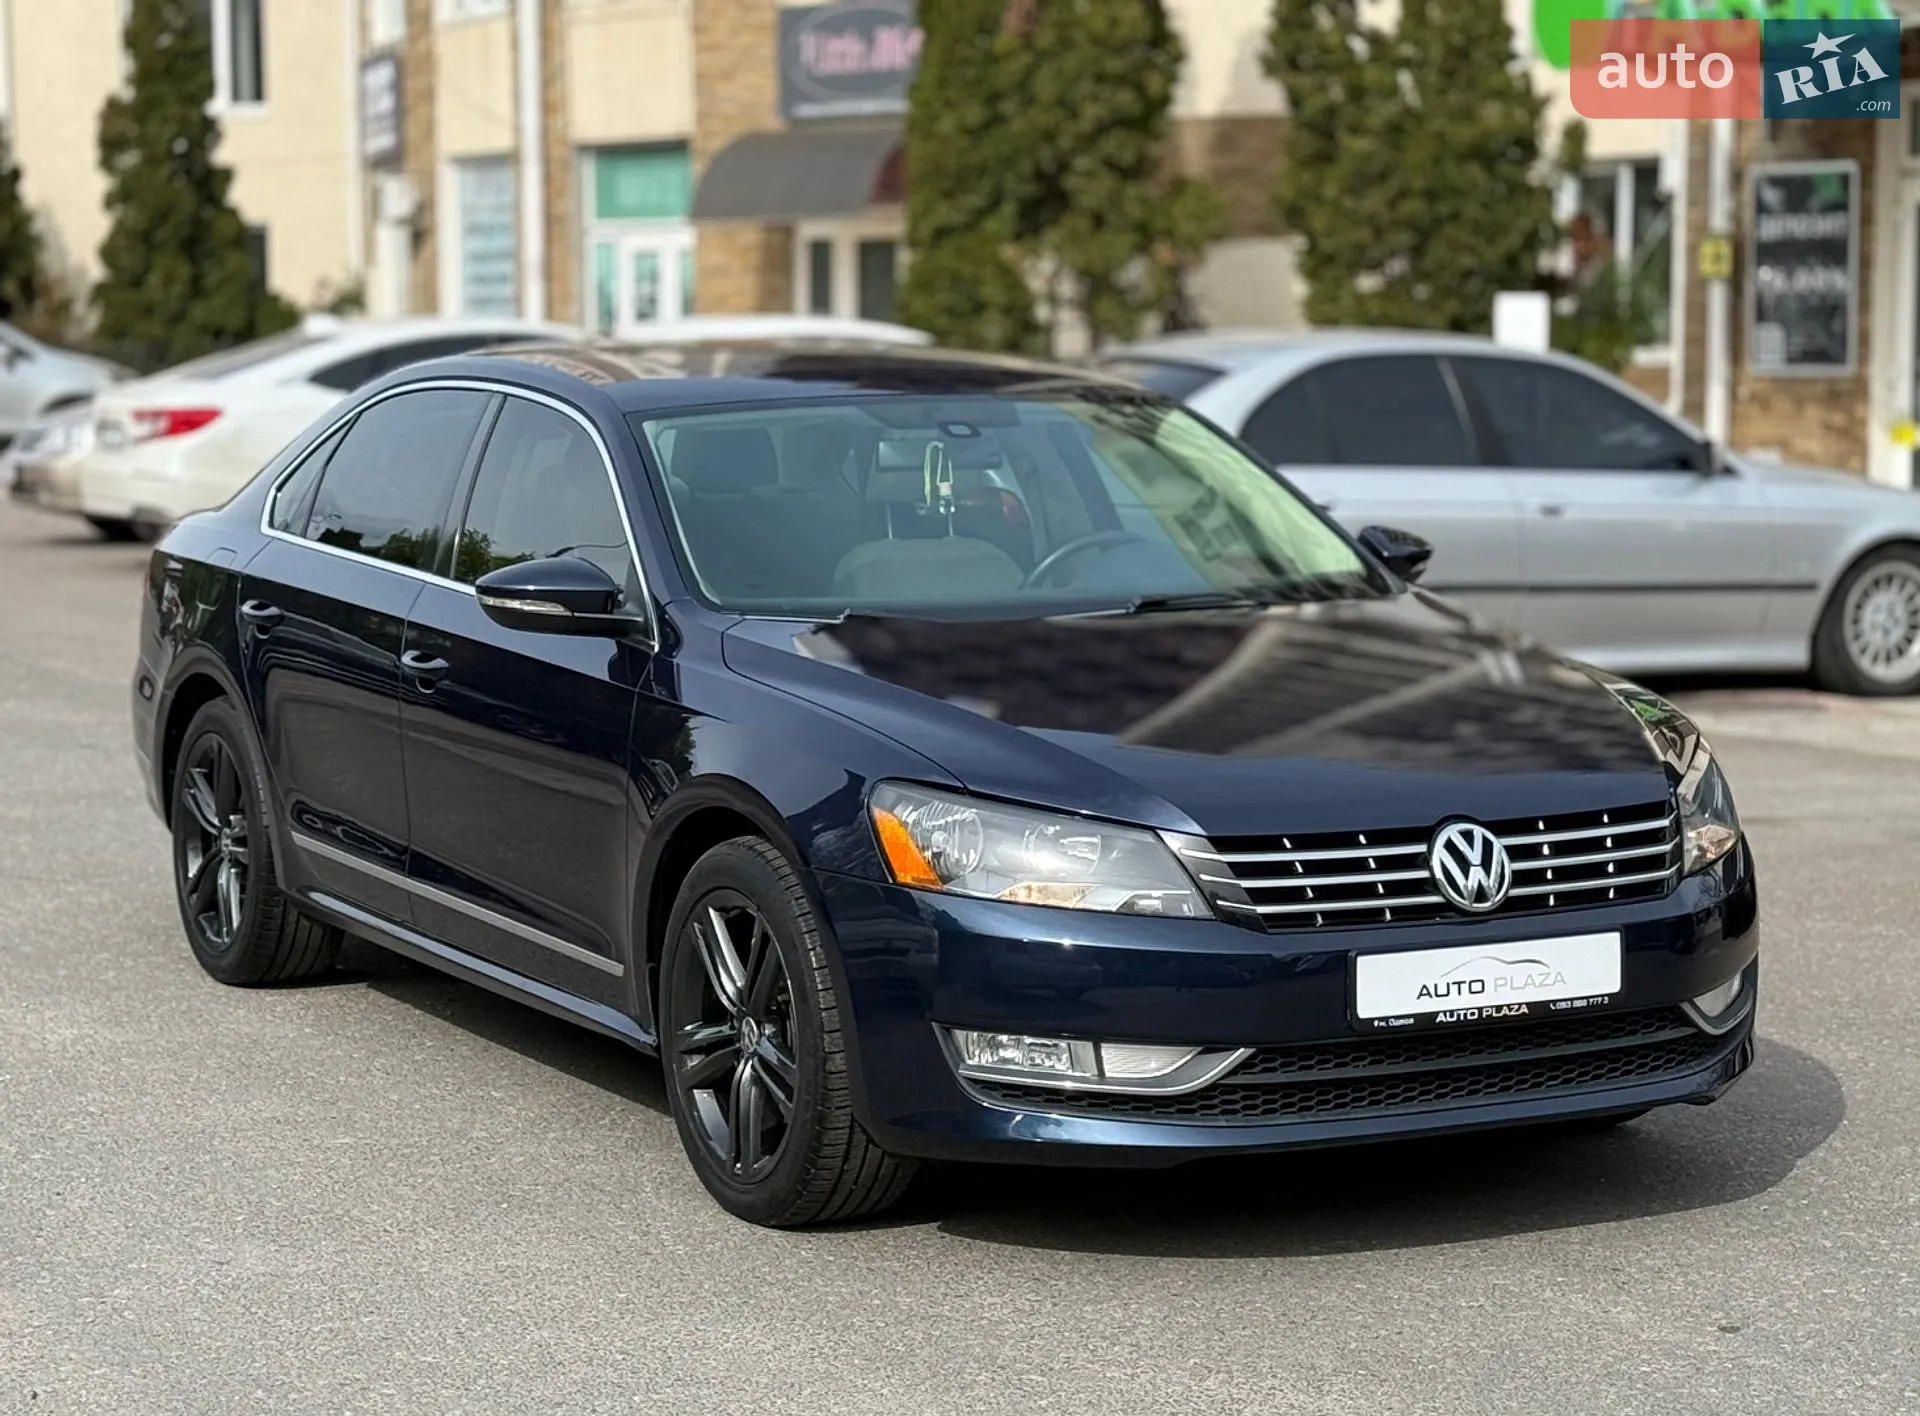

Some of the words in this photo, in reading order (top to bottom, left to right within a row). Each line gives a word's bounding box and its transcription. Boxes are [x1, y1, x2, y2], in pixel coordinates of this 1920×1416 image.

[1416, 979, 1485, 1000] AUTO
[1494, 971, 1567, 993] PLAZA
[1435, 1008, 1479, 1024] AUTO
[1482, 1004, 1529, 1019] PLAZA
